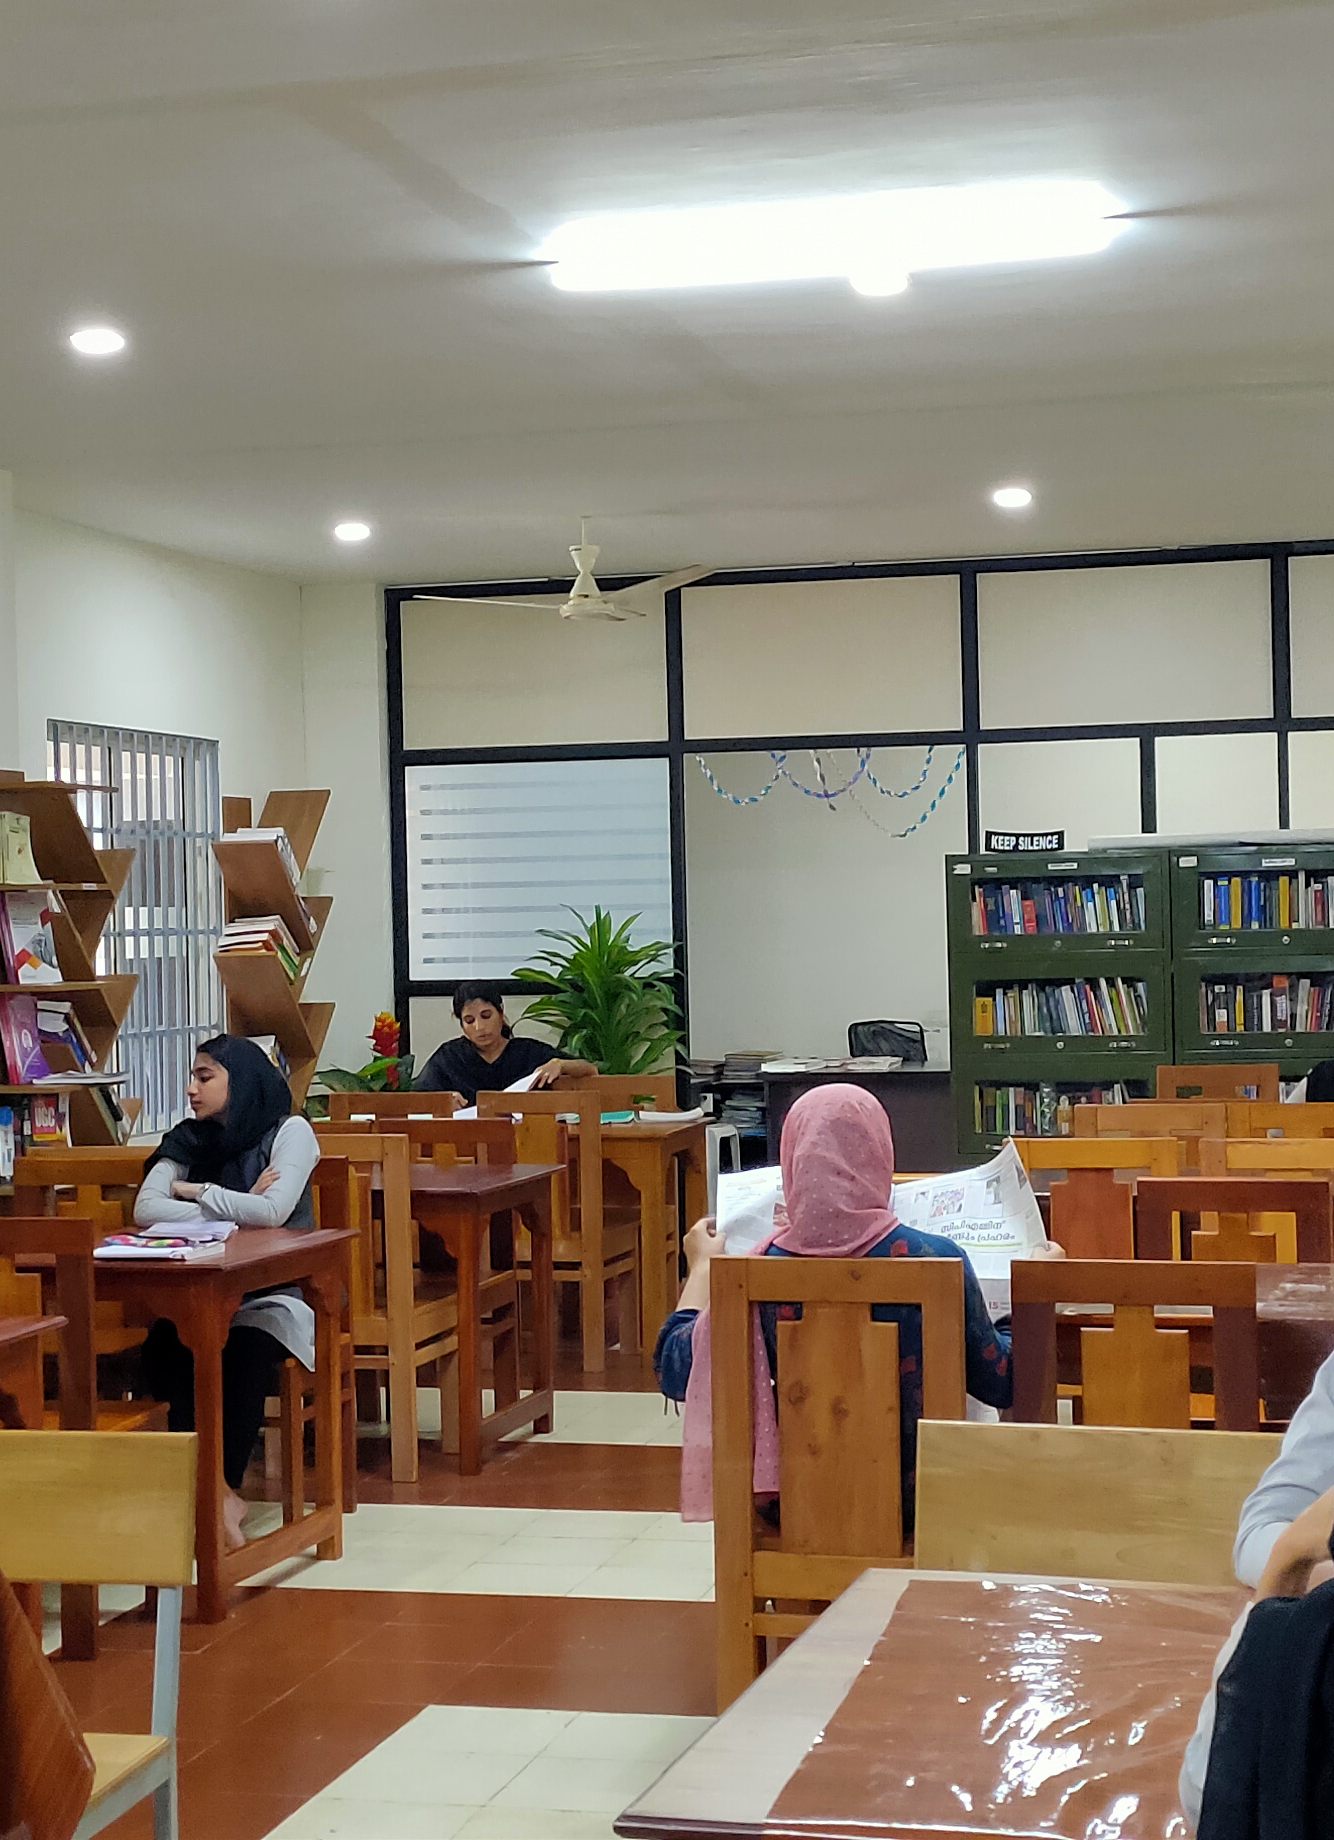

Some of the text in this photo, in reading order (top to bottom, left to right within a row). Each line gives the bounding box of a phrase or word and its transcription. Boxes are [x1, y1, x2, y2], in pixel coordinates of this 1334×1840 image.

[991, 834, 1059, 850] KEEP SILENCE
[34, 1107, 56, 1128] UGC
